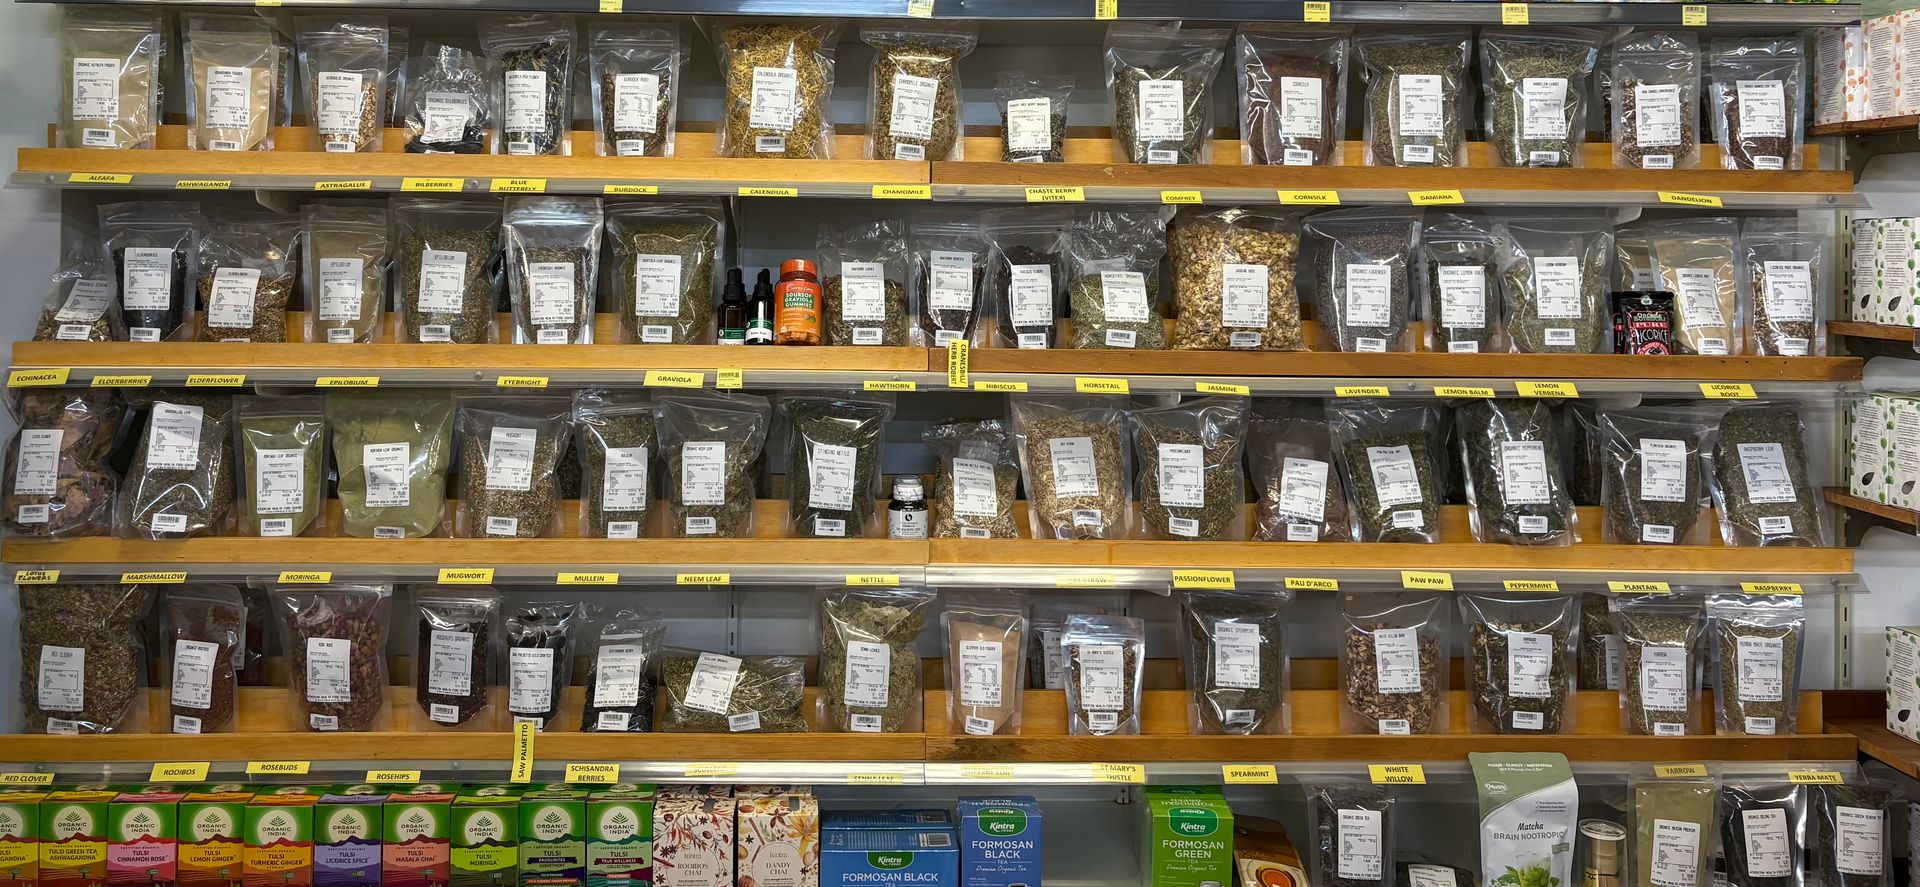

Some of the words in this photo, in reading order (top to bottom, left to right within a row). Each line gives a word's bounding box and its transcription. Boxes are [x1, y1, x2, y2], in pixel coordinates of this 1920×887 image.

[1671, 196, 1712, 204] DANDELION
[1634, 329, 1668, 345] LICORICE
[16, 374, 57, 382] ECHINACEA
[520, 724, 528, 761] PALMETTO
[518, 762, 526, 778] SAW
[989, 822, 1015, 831] Kintra
[1180, 823, 1205, 832] Kintra
[1517, 822, 1544, 831] Matcha
[1521, 831, 1565, 840] NOOTROPIC
[972, 841, 1034, 849] FORMOSAN
[1162, 840, 1224, 850] FORMOSAN
[985, 850, 1020, 859] BLACK
[1175, 850, 1212, 859] GREEN
[878, 856, 902, 864] Kintra
[842, 873, 902, 882] FORMOSAN
[904, 873, 938, 882] BLACK
